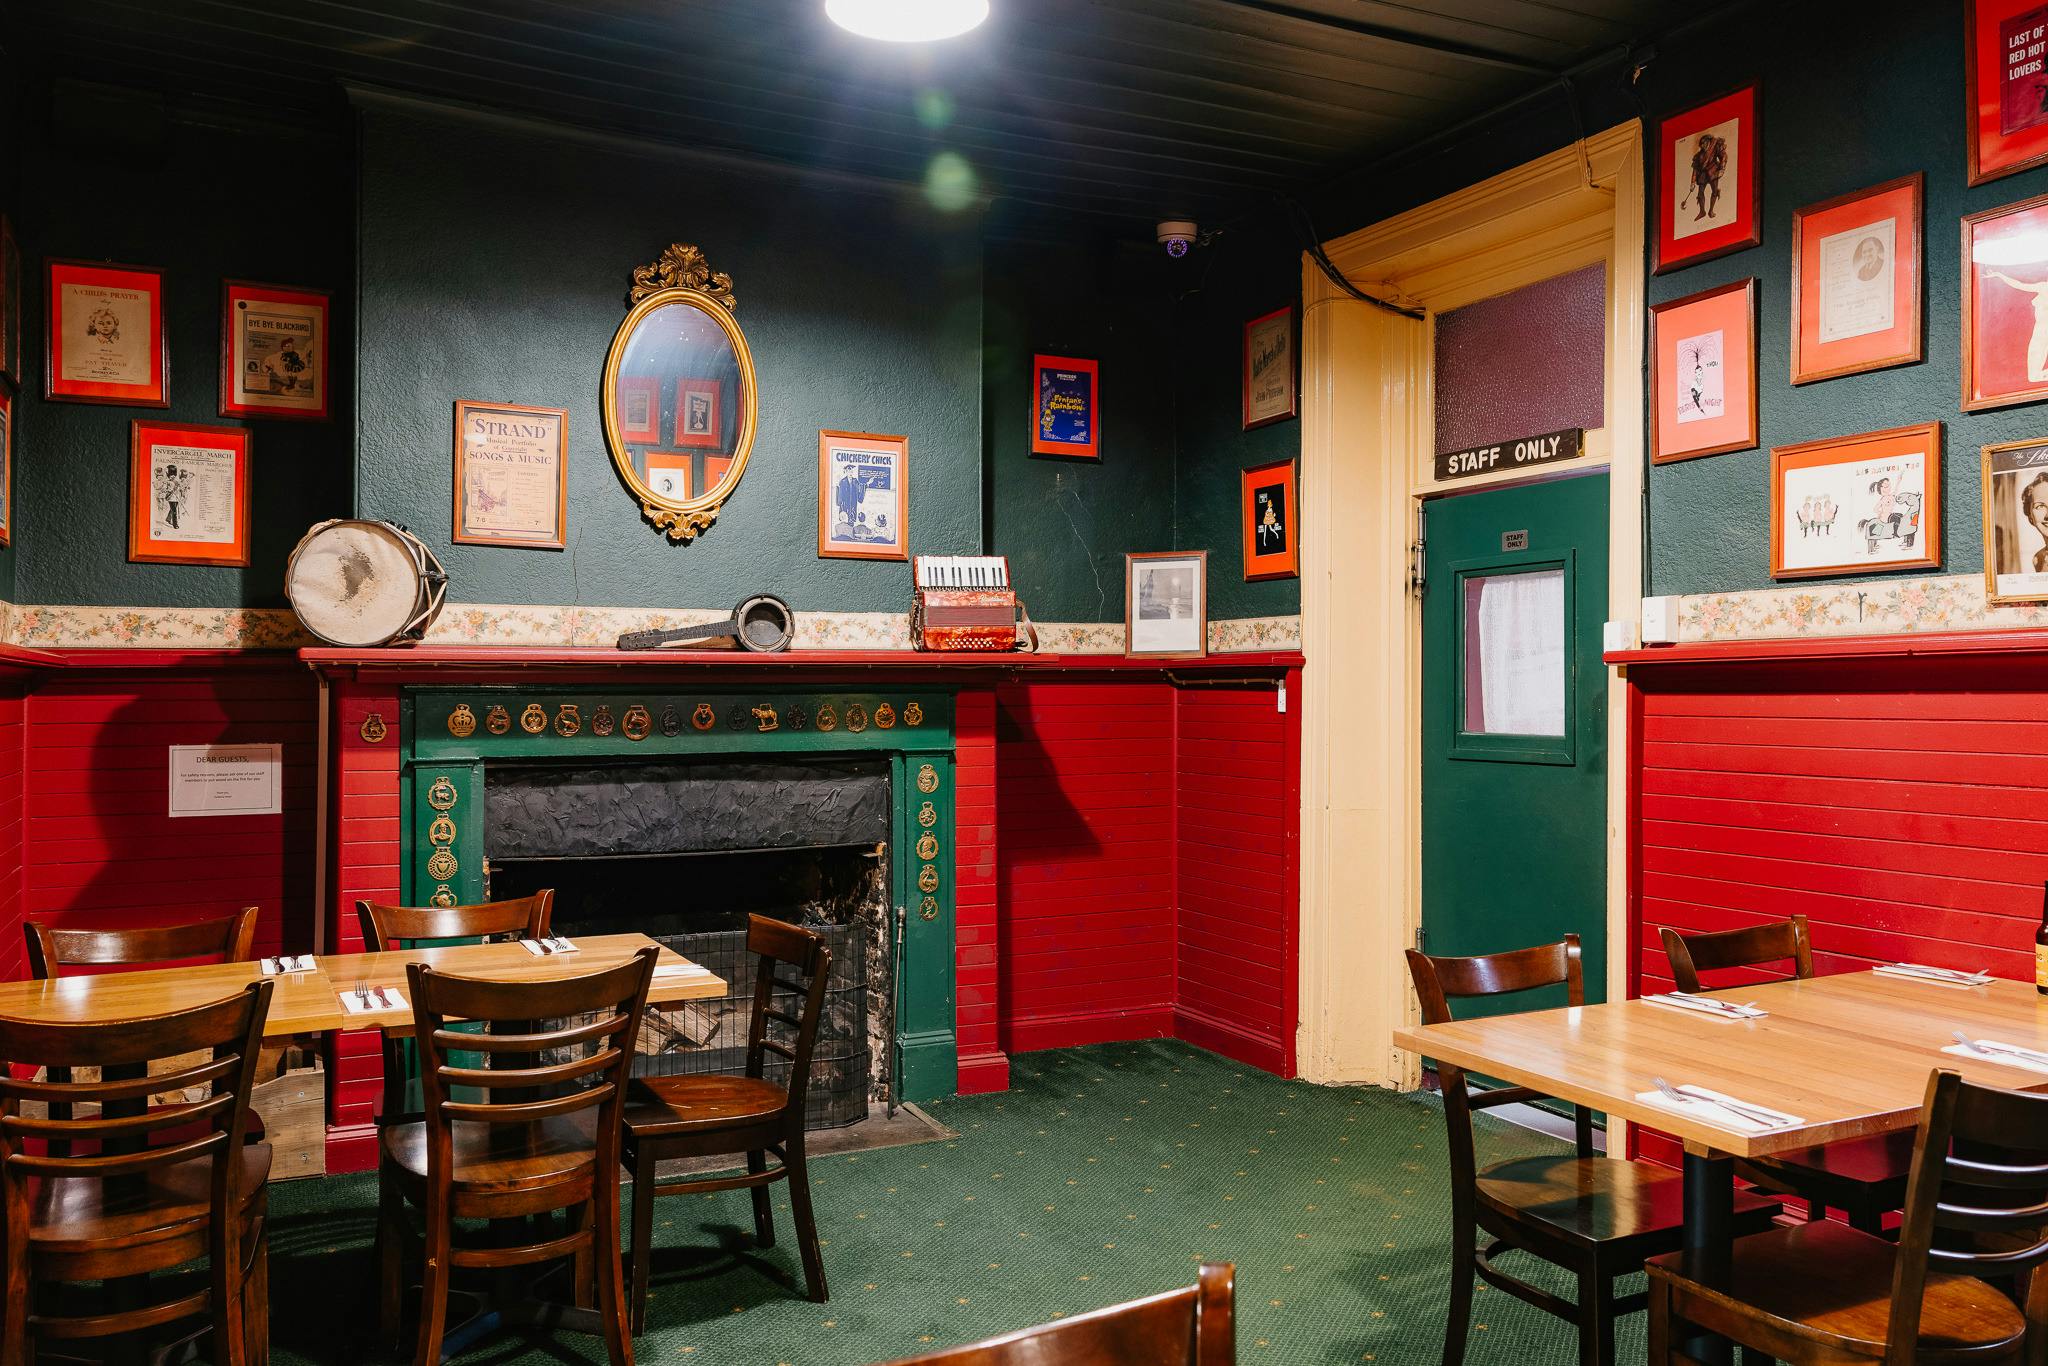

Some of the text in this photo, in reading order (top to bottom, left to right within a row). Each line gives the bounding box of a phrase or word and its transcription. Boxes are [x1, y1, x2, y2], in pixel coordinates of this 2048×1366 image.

[2009, 24, 2045, 49] LAST OF
[2009, 40, 2046, 65] RED HOT
[2009, 59, 2042, 80] LOVERS
[110, 292, 139, 300] PRAYER
[248, 319, 310, 332] BYE BYE BLACKBIRD
[1050, 401, 1083, 411] Rainbow
[206, 452, 232, 460] MARCH
[469, 450, 552, 465] SONGS & MUSIC
[836, 452, 892, 466] CHICKERY CHICK
[1448, 435, 1561, 474] STAFF ONLY
[1506, 533, 1524, 542] STAFF
[1507, 540, 1523, 548] ONLY
[196, 756, 217, 764] DEAR
